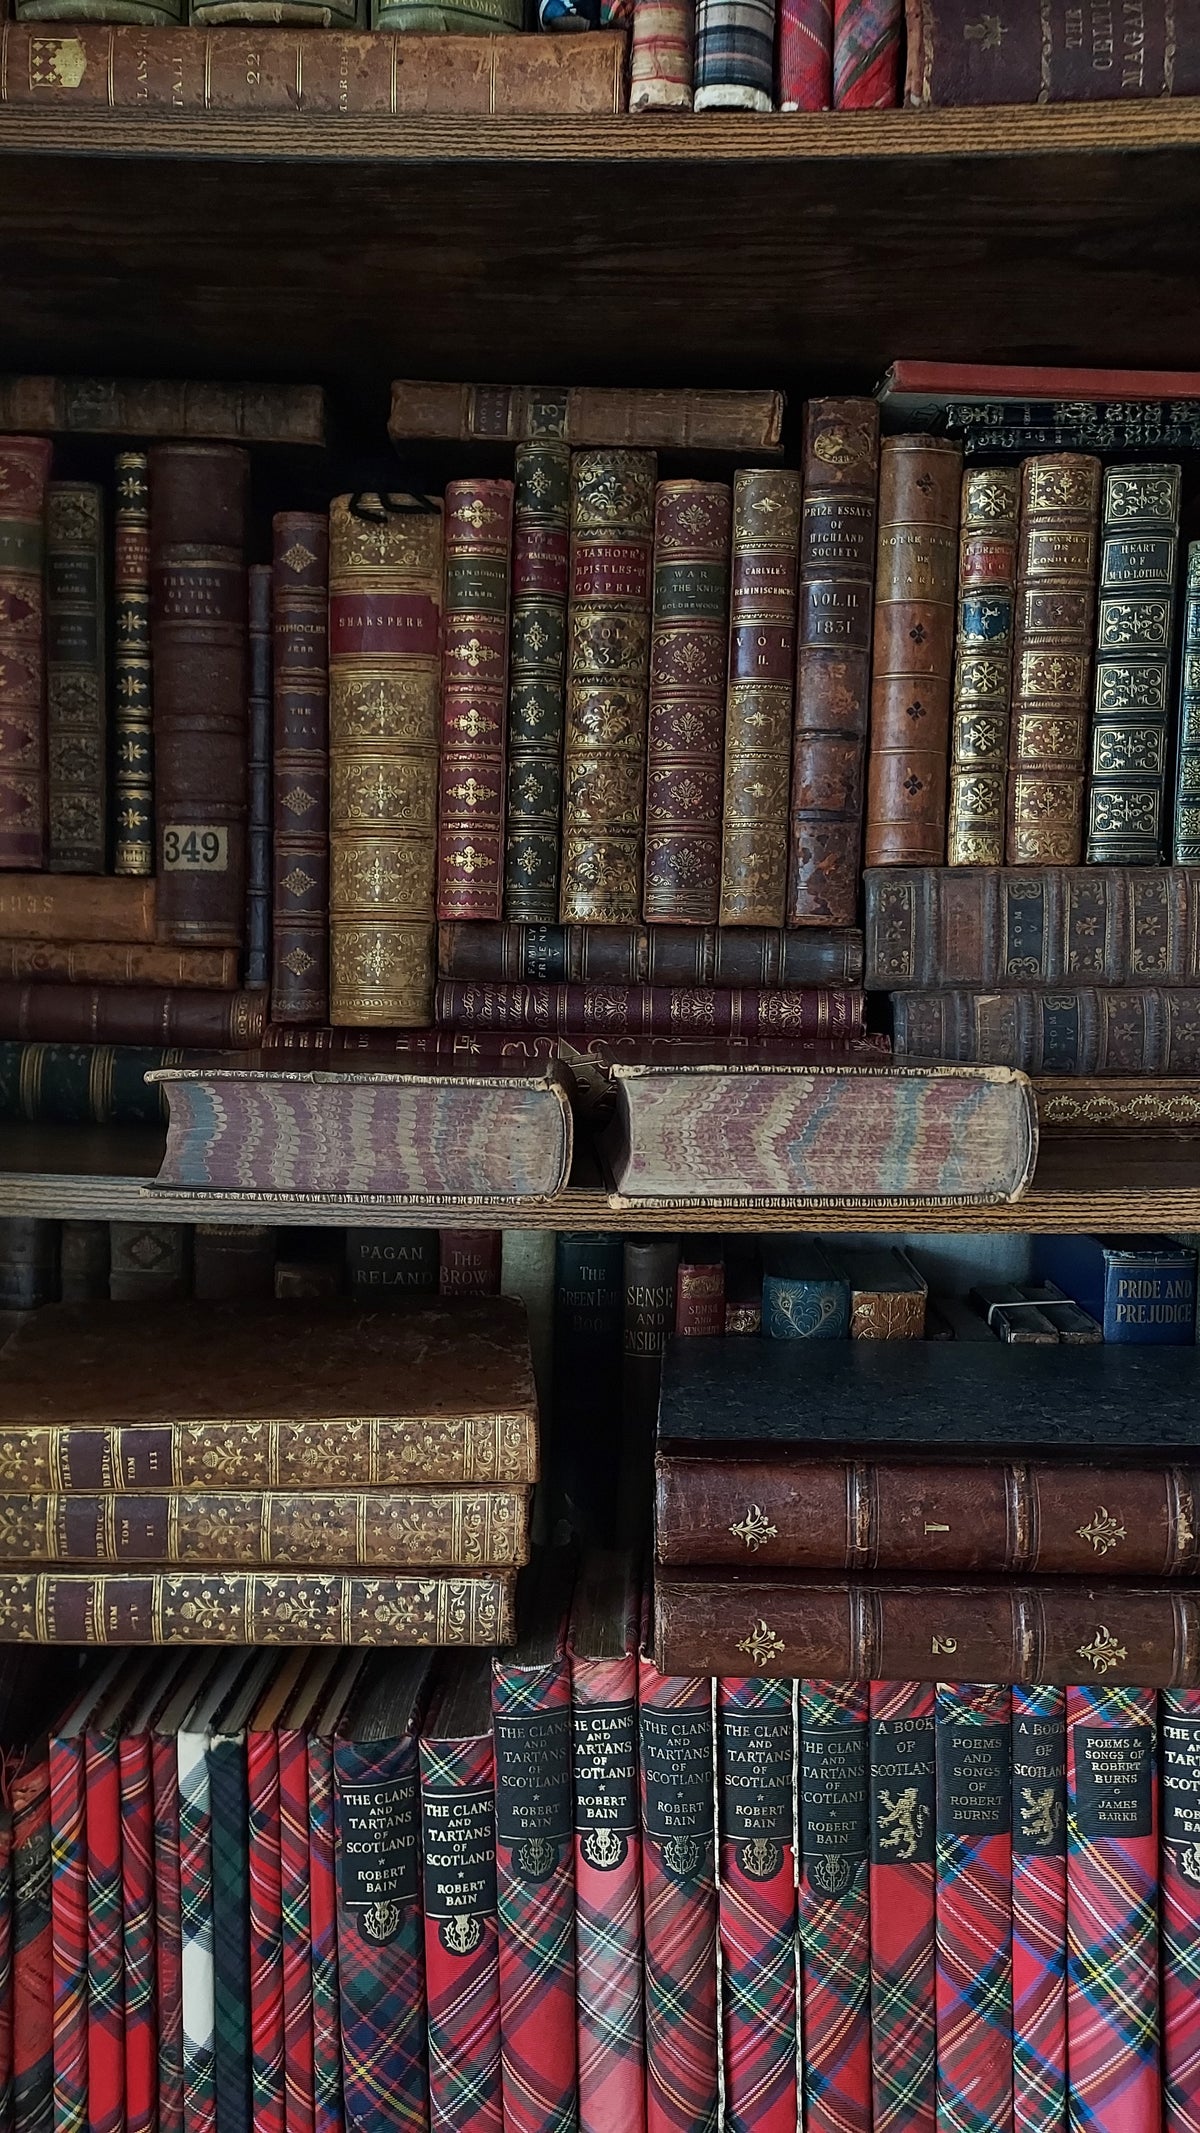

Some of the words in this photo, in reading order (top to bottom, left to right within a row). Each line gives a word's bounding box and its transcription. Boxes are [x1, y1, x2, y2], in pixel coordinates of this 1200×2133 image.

[1065, 8, 1084, 49] THE
[245, 53, 261, 85] 22
[804, 506, 833, 518] PRIZE
[838, 505, 872, 517] ESSAYS
[830, 519, 844, 529] OF
[810, 532, 864, 544] HIGHLAND
[576, 548, 646, 561] STANHOPE'S
[811, 546, 859, 558] SOCIETY
[1121, 543, 1156, 554] HEART
[917, 555, 929, 563] DE
[1129, 556, 1146, 566] OF
[673, 570, 709, 579] WAR
[745, 564, 787, 576] CARLYLE'S
[1109, 568, 1169, 581] MID-LOTHIAN
[575, 582, 642, 594] GOSPELS
[672, 583, 691, 592] THE
[339, 615, 424, 628] SHAKSPERE
[816, 619, 852, 634] 1831
[588, 628, 628, 640] VOL.
[736, 636, 791, 649] VOL.
[290, 707, 311, 715] THE
[164, 831, 221, 864] 349
[1013, 911, 1022, 948] TOM
[1029, 924, 1038, 933] V
[527, 928, 536, 974] FAMILY
[538, 925, 548, 978] FRIEND
[553, 949, 560, 957] V
[1048, 1015, 1058, 1050] TOM
[359, 1244, 424, 1260] PAGAN
[451, 1250, 482, 1267] THE
[579, 1265, 606, 1281] THE
[1117, 1279, 1161, 1299] PRIDE
[1165, 1279, 1193, 1299] AND
[636, 1313, 665, 1326] AND
[1115, 1303, 1193, 1324] PREJUDICE
[149, 1450, 158, 1471] III
[126, 1456, 136, 1480] TOM
[120, 1519, 129, 1545] TOM
[146, 1524, 154, 1537] II
[924, 1519, 950, 1536] 1
[109, 1605, 118, 1631] TOM
[931, 1634, 957, 1655] 2
[591, 1714, 634, 1732] CLANS
[644, 1719, 669, 1735] THE
[671, 1720, 712, 1736] CLANS
[875, 1721, 890, 1735] A
[892, 1718, 935, 1734] BOOK
[1018, 1722, 1030, 1735] A
[498, 1725, 526, 1739] THE
[724, 1723, 751, 1737] THE
[1163, 1725, 1190, 1741] THE
[586, 1732, 612, 1742] AND
[666, 1737, 691, 1746] AND
[952, 1738, 1001, 1749] POEMS
[1086, 1738, 1131, 1749] POEMS
[1133, 1738, 1142, 1748] &
[524, 1739, 548, 1749] AND
[748, 1739, 773, 1749] AND
[896, 1740, 916, 1753] OF
[1035, 1744, 1053, 1756] OF
[503, 1746, 567, 1764] TARTANS
[647, 1745, 711, 1760] TARTANS
[728, 1749, 792, 1764] TARTANS
[963, 1753, 992, 1763] AND
[1085, 1750, 1125, 1760] SONGS
[1130, 1749, 1145, 1760] OF
[592, 1756, 608, 1766] OF
[820, 1755, 846, 1765] AND
[1092, 1761, 1141, 1771] ROBERT
[528, 1765, 543, 1775] OF
[573, 1766, 636, 1780] COTLAND
[671, 1762, 687, 1772] OF
[752, 1765, 768, 1775] OF
[801, 1765, 866, 1779] TARTANS
[953, 1766, 1001, 1777] SONGS
[501, 1769, 570, 1787] SCOTLAND
[646, 1769, 712, 1785] SCOTLAND
[1094, 1773, 1138, 1784] BURNS
[825, 1781, 841, 1790] OF
[968, 1782, 987, 1792] OF
[343, 1792, 371, 1806] THE
[374, 1785, 416, 1806] CLANS
[577, 1795, 627, 1806] ROBERT
[950, 1795, 1002, 1806] ROBERT
[368, 1805, 393, 1817] AND
[423, 1803, 450, 1818] THE
[452, 1799, 495, 1817] CLANS
[512, 1803, 561, 1817] ROBERT
[657, 1801, 705, 1813] ROBERT
[735, 1804, 786, 1816] ROBERT
[1098, 1799, 1138, 1810] JAMES
[586, 1808, 619, 1819] BAIN
[952, 1809, 1000, 1821] BURNS
[1098, 1811, 1138, 1822] BARKE
[348, 1810, 413, 1831] TARTANS
[447, 1817, 472, 1828] AND
[520, 1817, 552, 1828] BAIN
[664, 1815, 696, 1826] BAIN
[744, 1817, 777, 1828] BAIN
[807, 1820, 858, 1831] ROBERT
[373, 1830, 389, 1840] OF
[428, 1826, 492, 1842] TARTANS
[816, 1834, 849, 1844] BAIN
[346, 1834, 416, 1854] SCOTLAND
[453, 1843, 468, 1853] OF
[426, 1850, 496, 1867] SCOTLAND
[357, 1865, 406, 1881] ROBERT
[365, 1879, 398, 1893] BAIN
[436, 1879, 486, 1894] ROBERT
[445, 1893, 478, 1907] BAIN
